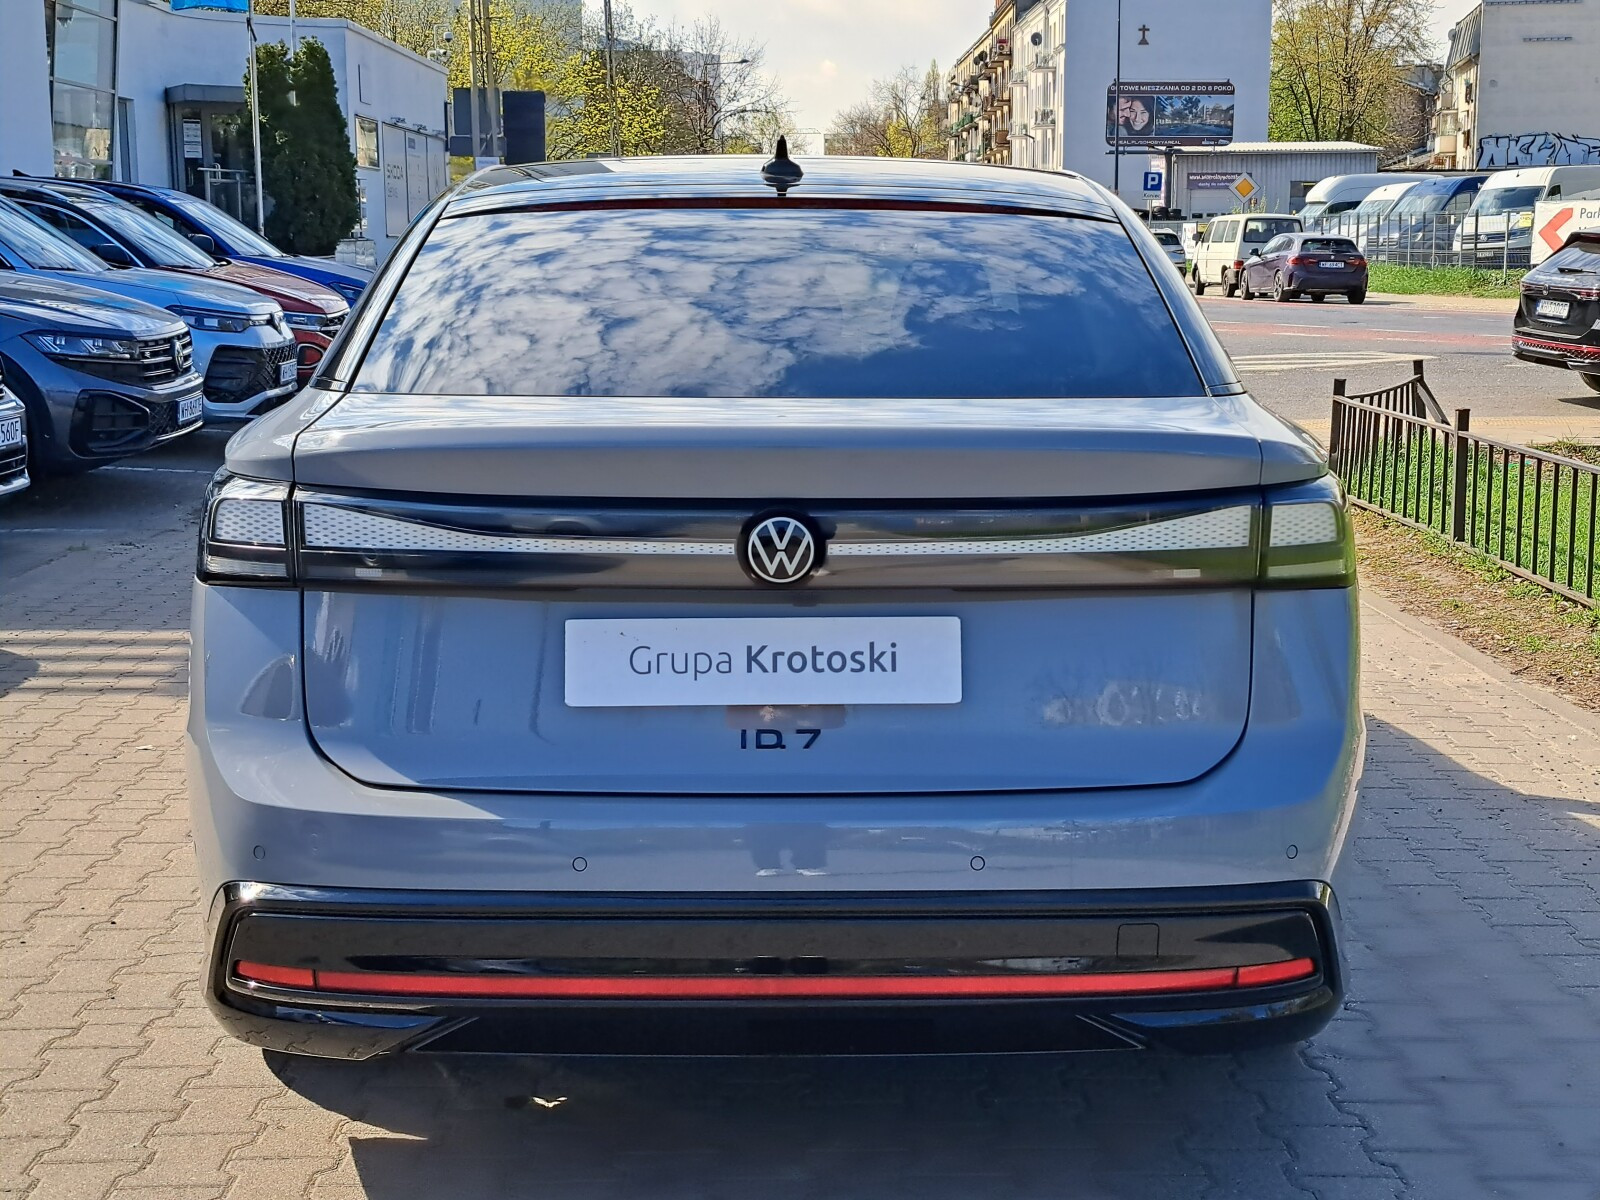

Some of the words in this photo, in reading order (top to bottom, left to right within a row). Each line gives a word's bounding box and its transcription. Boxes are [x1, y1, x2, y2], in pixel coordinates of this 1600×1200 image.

[1147, 173, 1159, 189] P
[629, 645, 732, 681] Grupa
[746, 641, 897, 674] Krotoski
